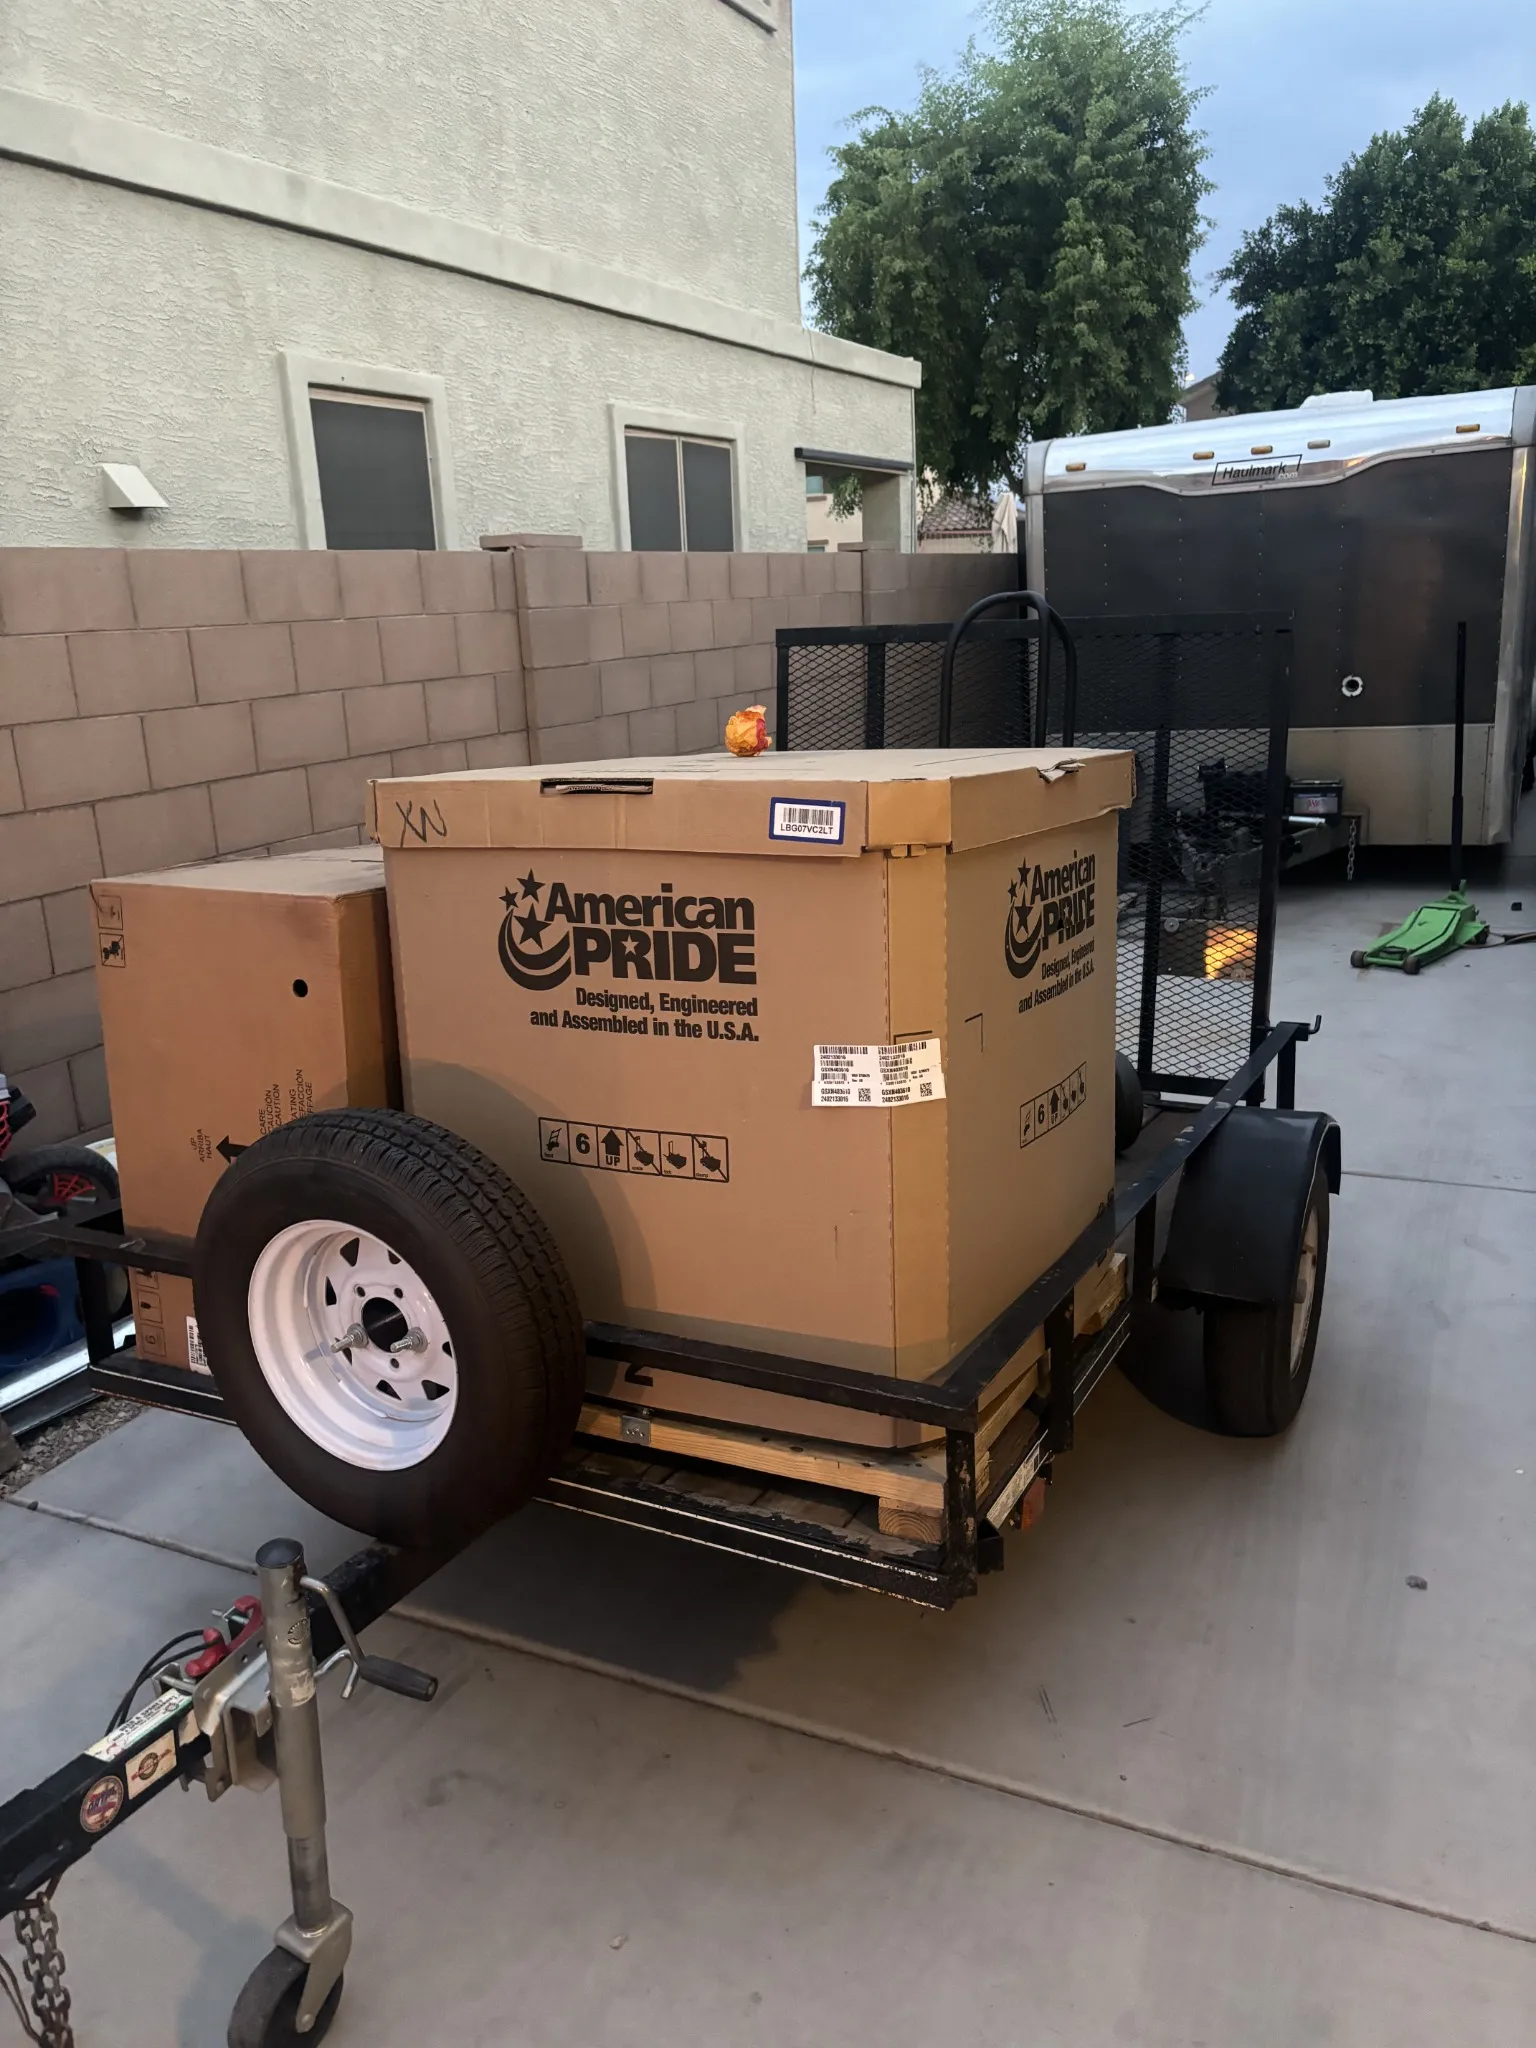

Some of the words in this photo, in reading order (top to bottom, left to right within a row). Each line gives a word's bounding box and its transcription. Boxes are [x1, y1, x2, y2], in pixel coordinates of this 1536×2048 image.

[1223, 462, 1286, 479] Haulmark
[780, 823, 834, 835] LBG07VC2LT
[1030, 850, 1096, 904] American
[543, 882, 755, 930] American
[1042, 883, 1095, 951] PRIDE
[572, 926, 757, 985] PRIDE
[1042, 951, 1070, 980] Designed,
[1071, 936, 1095, 965] Engineered
[576, 987, 655, 1014] Designed,
[659, 993, 758, 1017] Engineered
[1018, 992, 1032, 1014] and
[1034, 974, 1068, 1006] Assembled
[1069, 972, 1074, 989] in
[530, 1009, 558, 1028] and
[561, 1010, 648, 1035] Assembled
[653, 1017, 669, 1036] in
[673, 1019, 703, 1039] the
[706, 1021, 760, 1042] U.S.A.
[272, 1083, 282, 1127] CAUTION
[288, 1088, 298, 1122] ATING
[1038, 1103, 1045, 1124] 6
[1051, 1112, 1058, 1125] UP
[258, 1108, 267, 1135] CARE
[190, 1137, 197, 1151] UP
[197, 1128, 205, 1162] ARRIBA
[204, 1135, 212, 1159] HAUT
[575, 1133, 590, 1154] 6
[605, 1155, 621, 1166] UP
